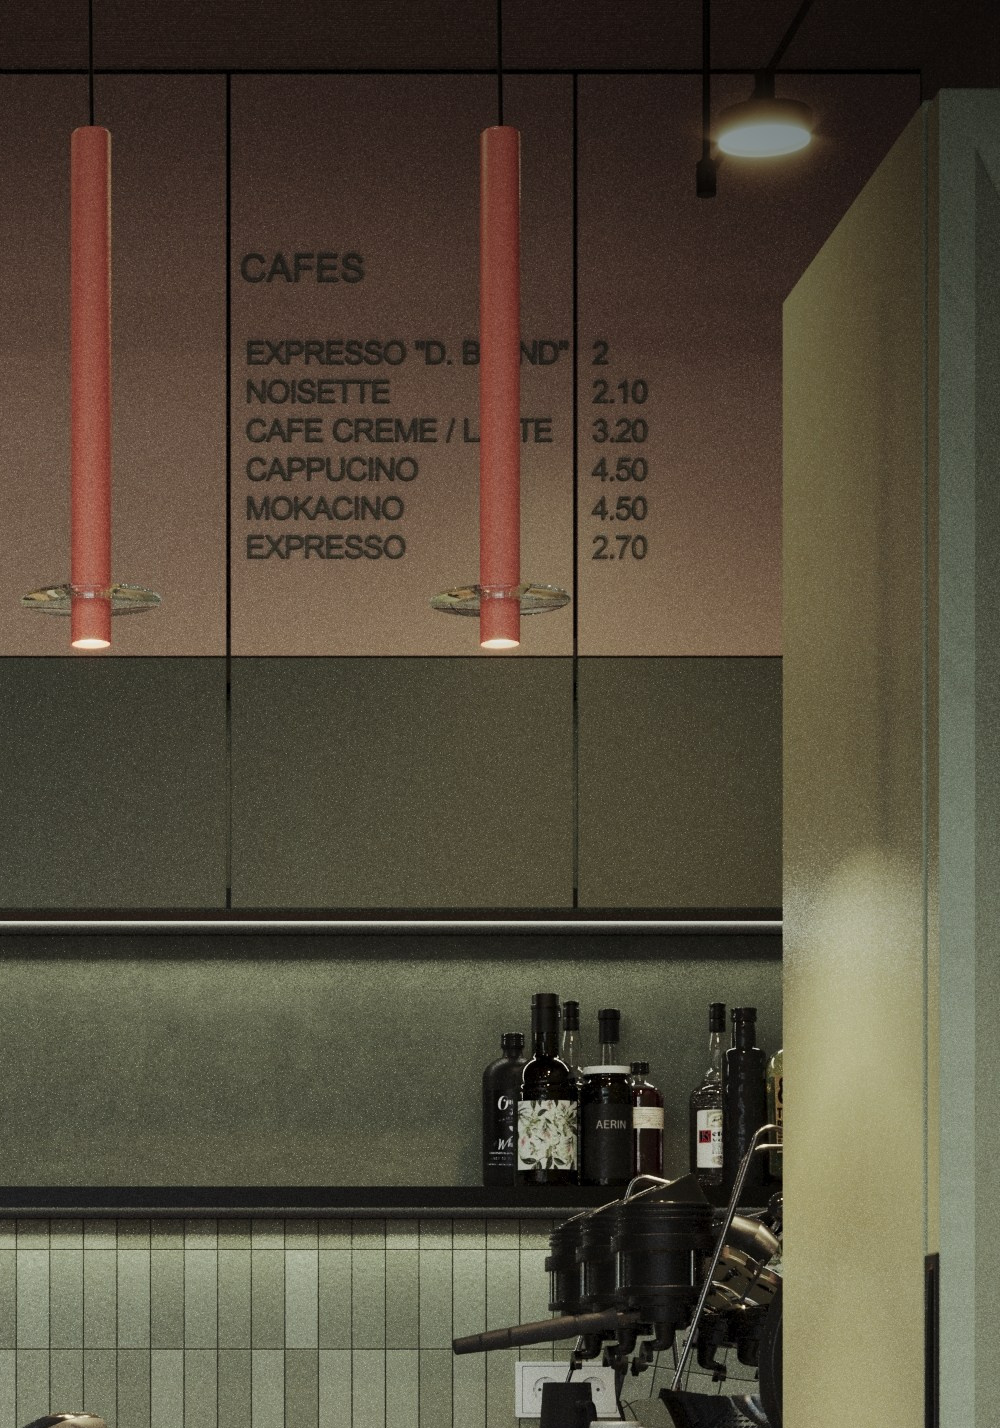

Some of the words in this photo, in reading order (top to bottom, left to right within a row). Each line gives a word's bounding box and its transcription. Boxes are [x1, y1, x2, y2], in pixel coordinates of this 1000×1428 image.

[240, 252, 365, 283] CAFES
[246, 339, 407, 365] EXPRESSO
[462, 340, 569, 365] BND"
[592, 340, 609, 365] 2
[246, 379, 390, 404] NOISETTE
[593, 379, 648, 404] 2.10
[246, 418, 323, 443] CAFE
[333, 418, 437, 443] CREME
[446, 418, 456, 443] /
[463, 417, 553, 443] LTE
[593, 418, 648, 443] 3.20
[246, 457, 419, 482] CAPPUCINO
[591, 457, 648, 482] 4.50
[246, 496, 405, 521] MOKACINO
[591, 496, 648, 521] 4.50
[246, 534, 406, 560] EXPRESSO
[592, 535, 648, 560] 2.70
[596, 1119, 627, 1130] AERIN
